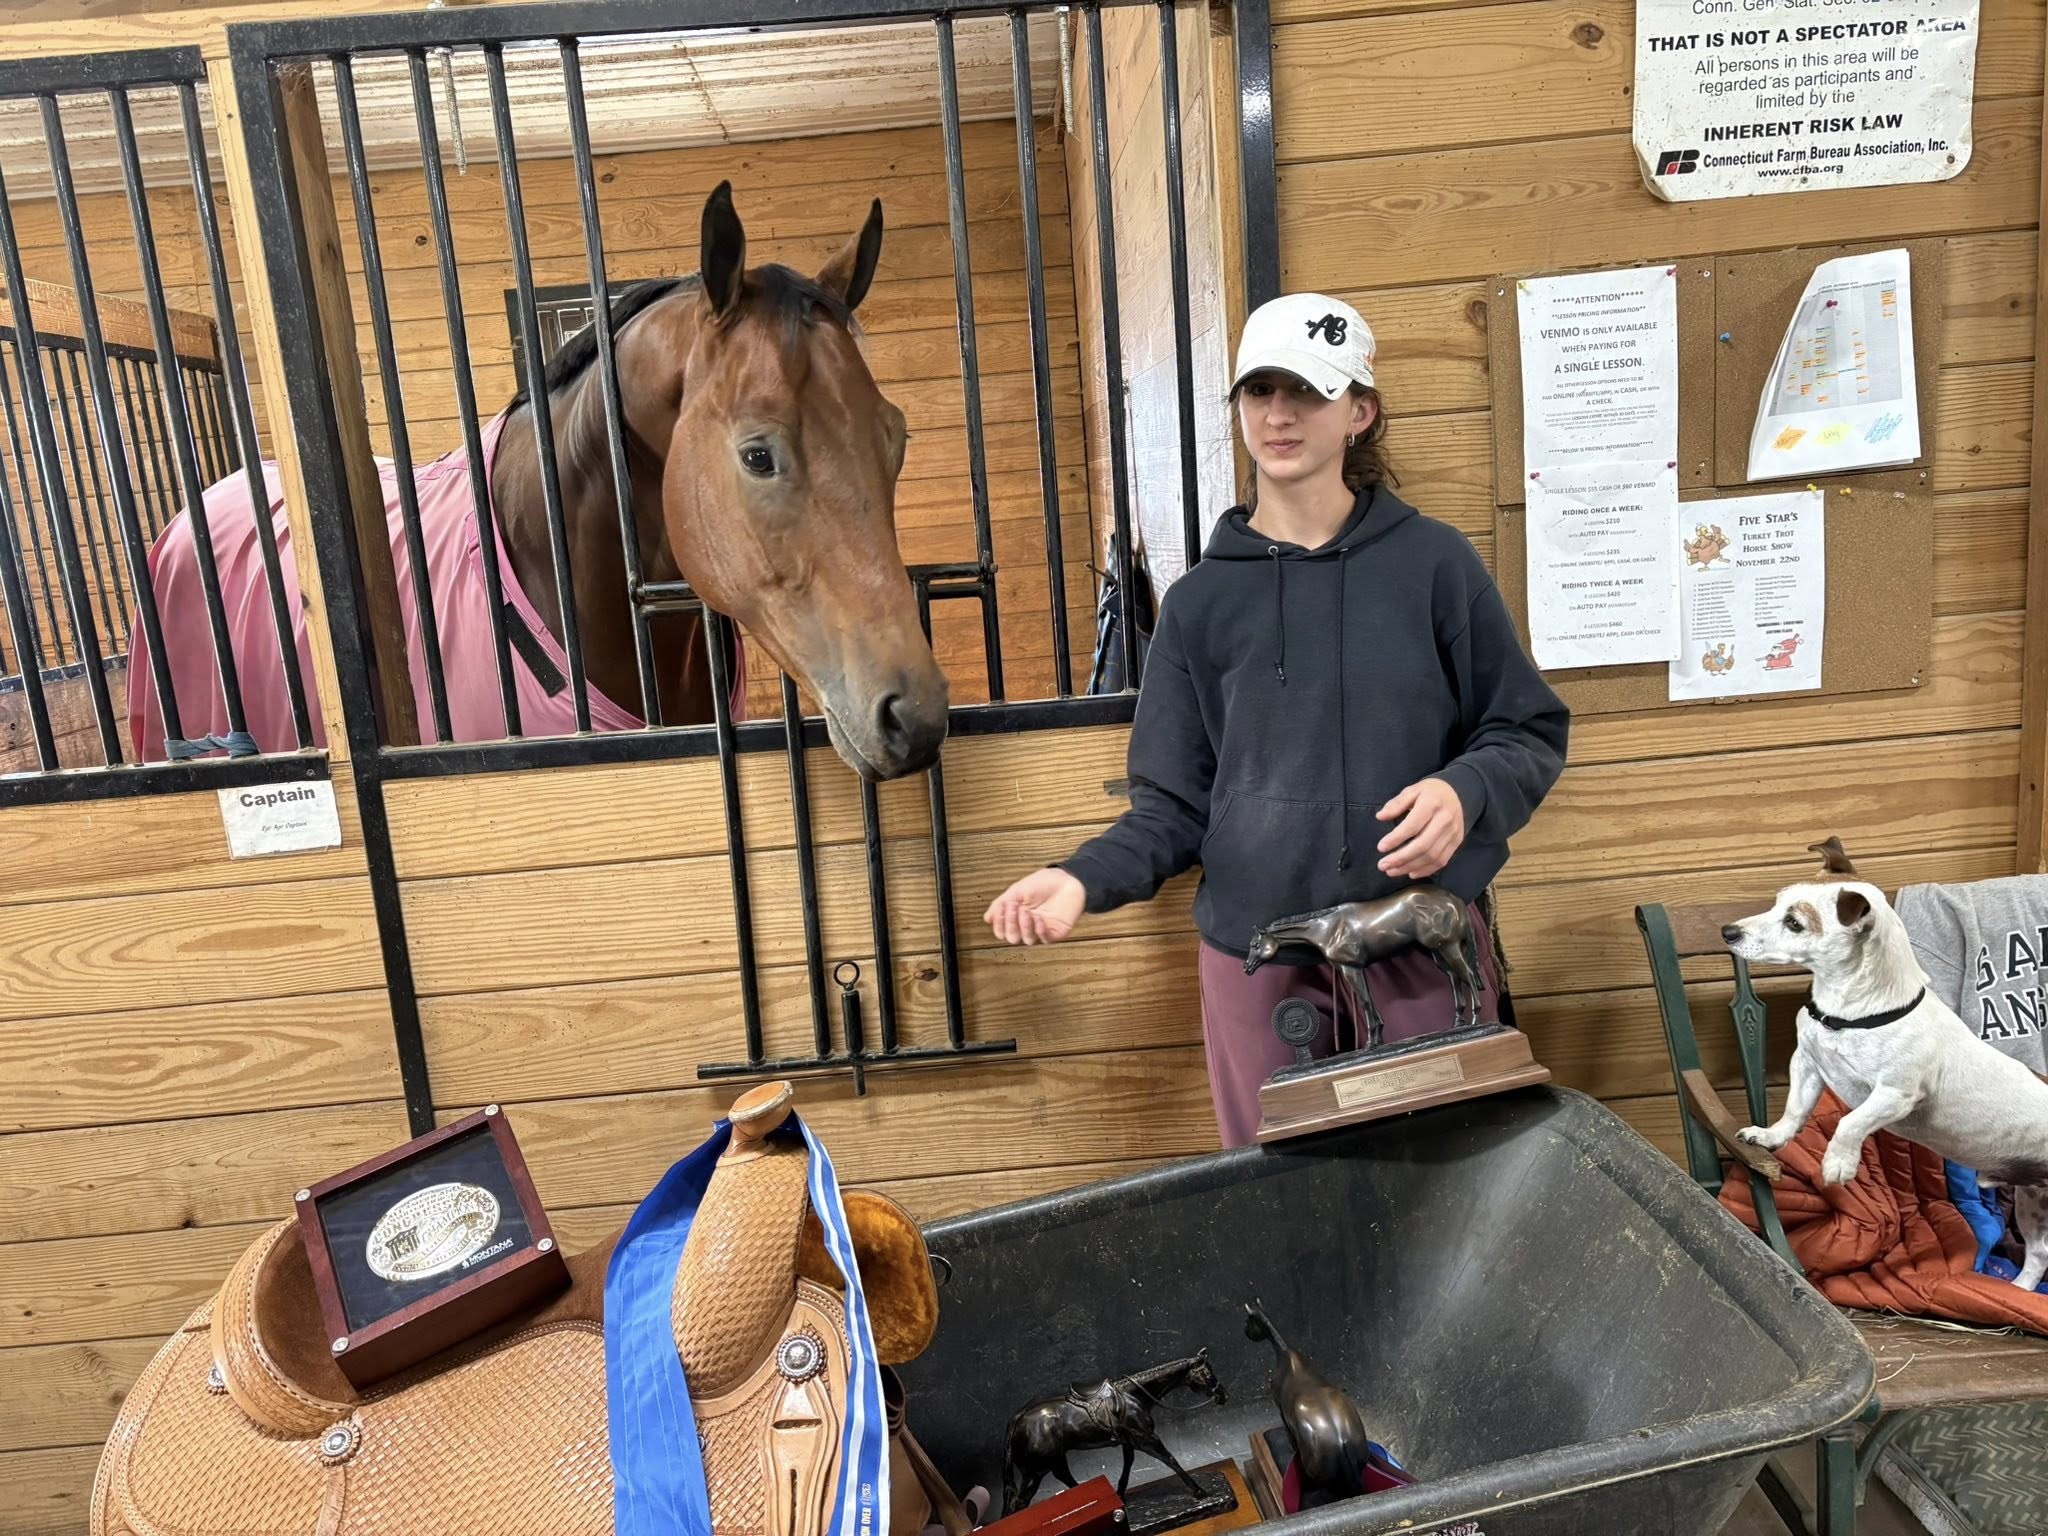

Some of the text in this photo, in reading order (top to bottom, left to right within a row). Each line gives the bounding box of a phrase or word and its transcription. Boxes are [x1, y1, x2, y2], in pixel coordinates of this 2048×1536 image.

[1692, 0, 1737, 14] Conn.
[1649, 35, 1699, 52] THAT
[1705, 32, 1725, 48] IS
[1731, 29, 1771, 46] NOT
[1776, 28, 1790, 44] A
[1795, 20, 1908, 42] SPECTATOR
[1695, 47, 1920, 79] All persons in this area will be
[1699, 67, 1913, 96] regarded as participants and
[1755, 89, 1856, 110] limited by the
[1704, 114, 1903, 142] INHERENT RISK LAW
[1703, 138, 1949, 168] Connecticut Farm Bureau Association, Inc.
[1757, 164, 1844, 179] www.cfba.org
[1578, 309, 1600, 318] PRICING
[1540, 321, 1658, 339] VENMO IS ONLY AVAILABLE
[1561, 339, 1637, 353] WHEN PAYING FOR
[1554, 357, 1645, 374] A SINGLE LESSON.
[1553, 392, 1575, 400] ONLINE
[1620, 386, 1639, 395] CASH,
[1592, 398, 1614, 406] CHECK.
[1565, 486, 1587, 494] LESSON
[1633, 481, 1656, 489] VENMO
[1562, 508, 1589, 516] RIDING
[1590, 506, 1610, 514] ONCE
[1619, 504, 1643, 512] WEEK:
[1605, 517, 1621, 525] $210
[1739, 512, 1798, 526] FIVE STAR'S
[1579, 530, 1596, 538] AUTO
[1597, 529, 1609, 537] PAY
[1742, 530, 1794, 541] TURKEY TROT
[1743, 542, 1793, 553] HORSE SHOW
[1736, 556, 1800, 568] NOVEMBER 22ND
[1589, 580, 1613, 588] TWICE
[240, 787, 315, 807] Captain
[469, 1238, 513, 1262] MONTANA
[861, 1507, 871, 1524] OVER
